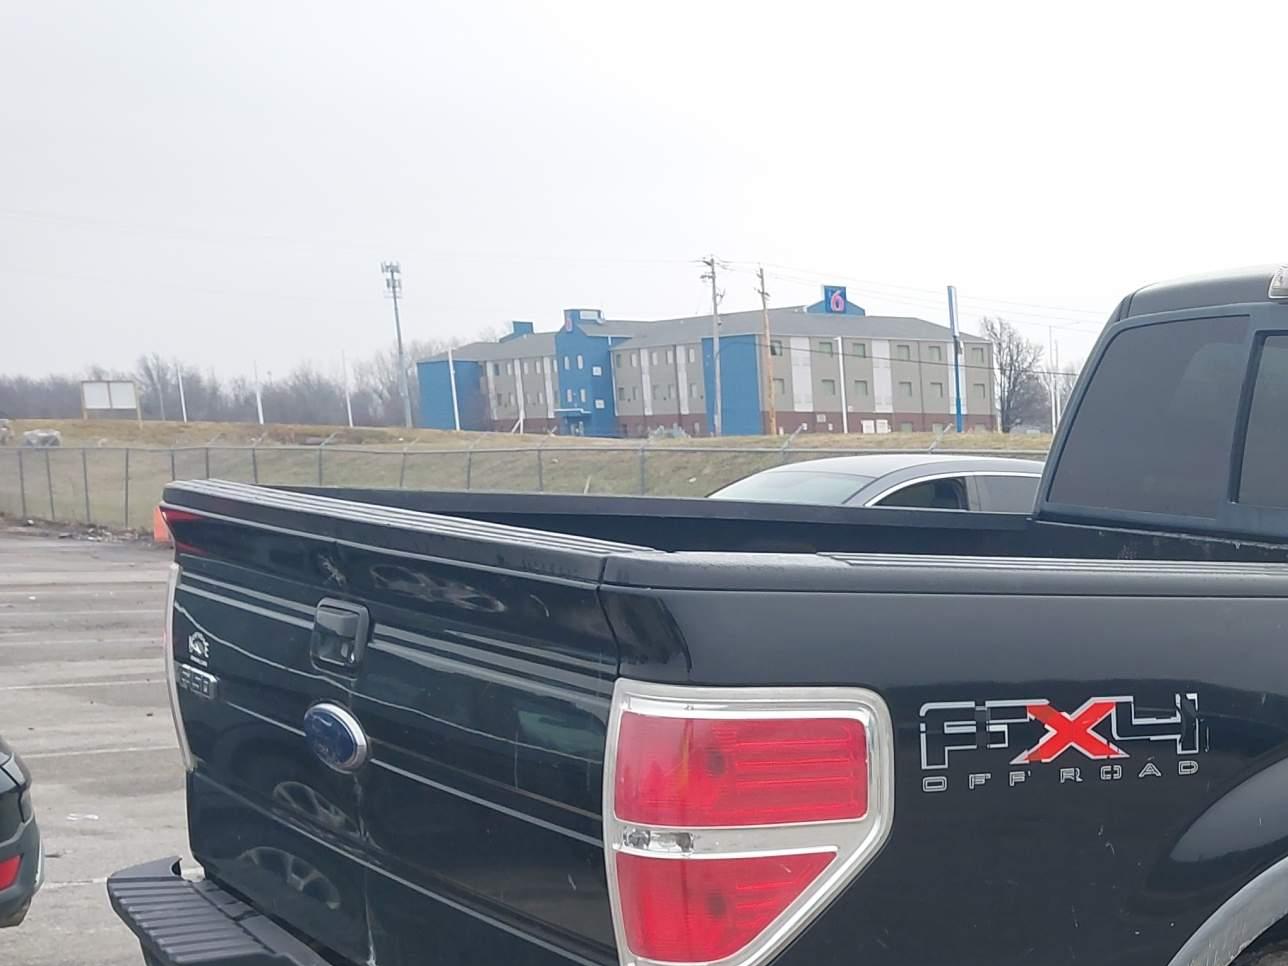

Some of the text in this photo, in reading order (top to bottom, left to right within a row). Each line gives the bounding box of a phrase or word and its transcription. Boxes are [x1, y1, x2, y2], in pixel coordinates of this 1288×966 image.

[831, 290, 845, 312] 6
[919, 693, 1199, 769] FX4
[922, 759, 1199, 792] OFF ROAD
